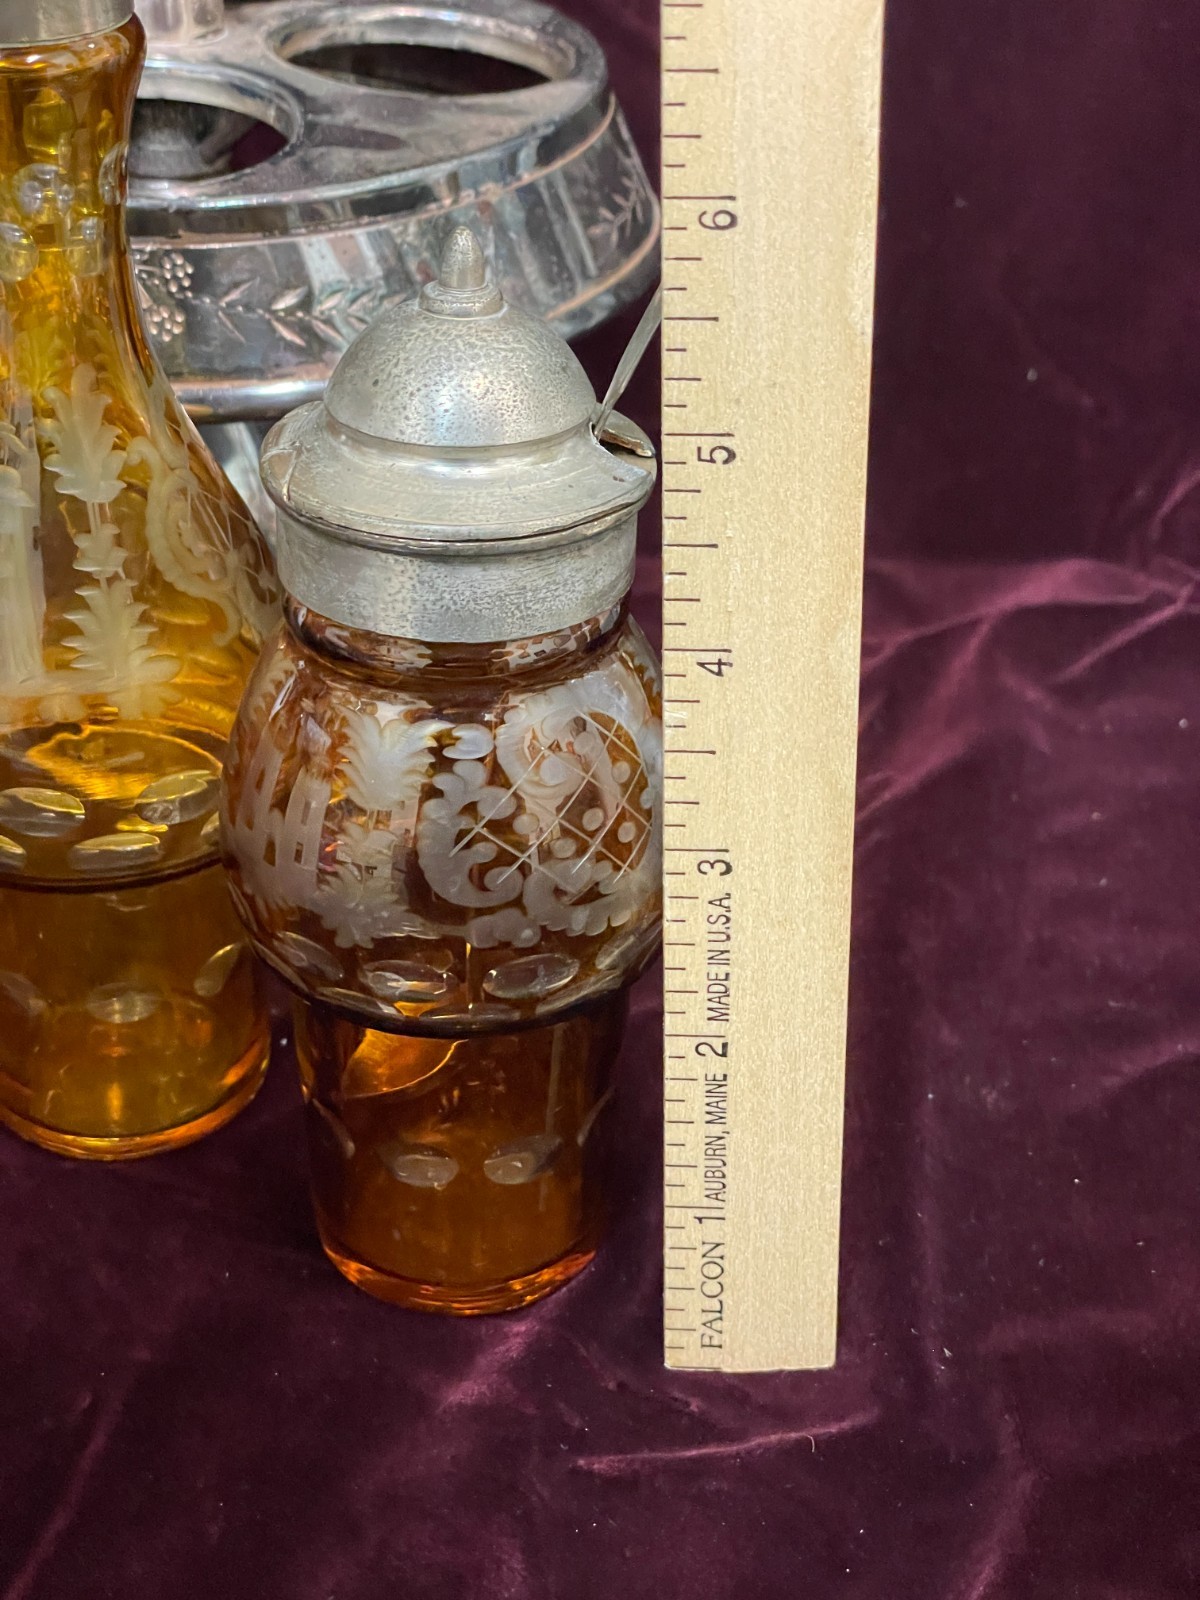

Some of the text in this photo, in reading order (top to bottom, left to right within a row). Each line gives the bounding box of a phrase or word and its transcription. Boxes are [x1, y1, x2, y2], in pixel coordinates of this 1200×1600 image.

[698, 209, 738, 231] 6
[697, 445, 737, 465] 5
[696, 658, 733, 677] 4
[697, 859, 733, 877] 3
[706, 892, 732, 1022] MADE IN U.S.A.
[694, 1041, 729, 1058] 2
[704, 1073, 730, 1202] AUBURN, MAINE
[693, 1216, 726, 1225] 1
[700, 1241, 725, 1350] FALCON
